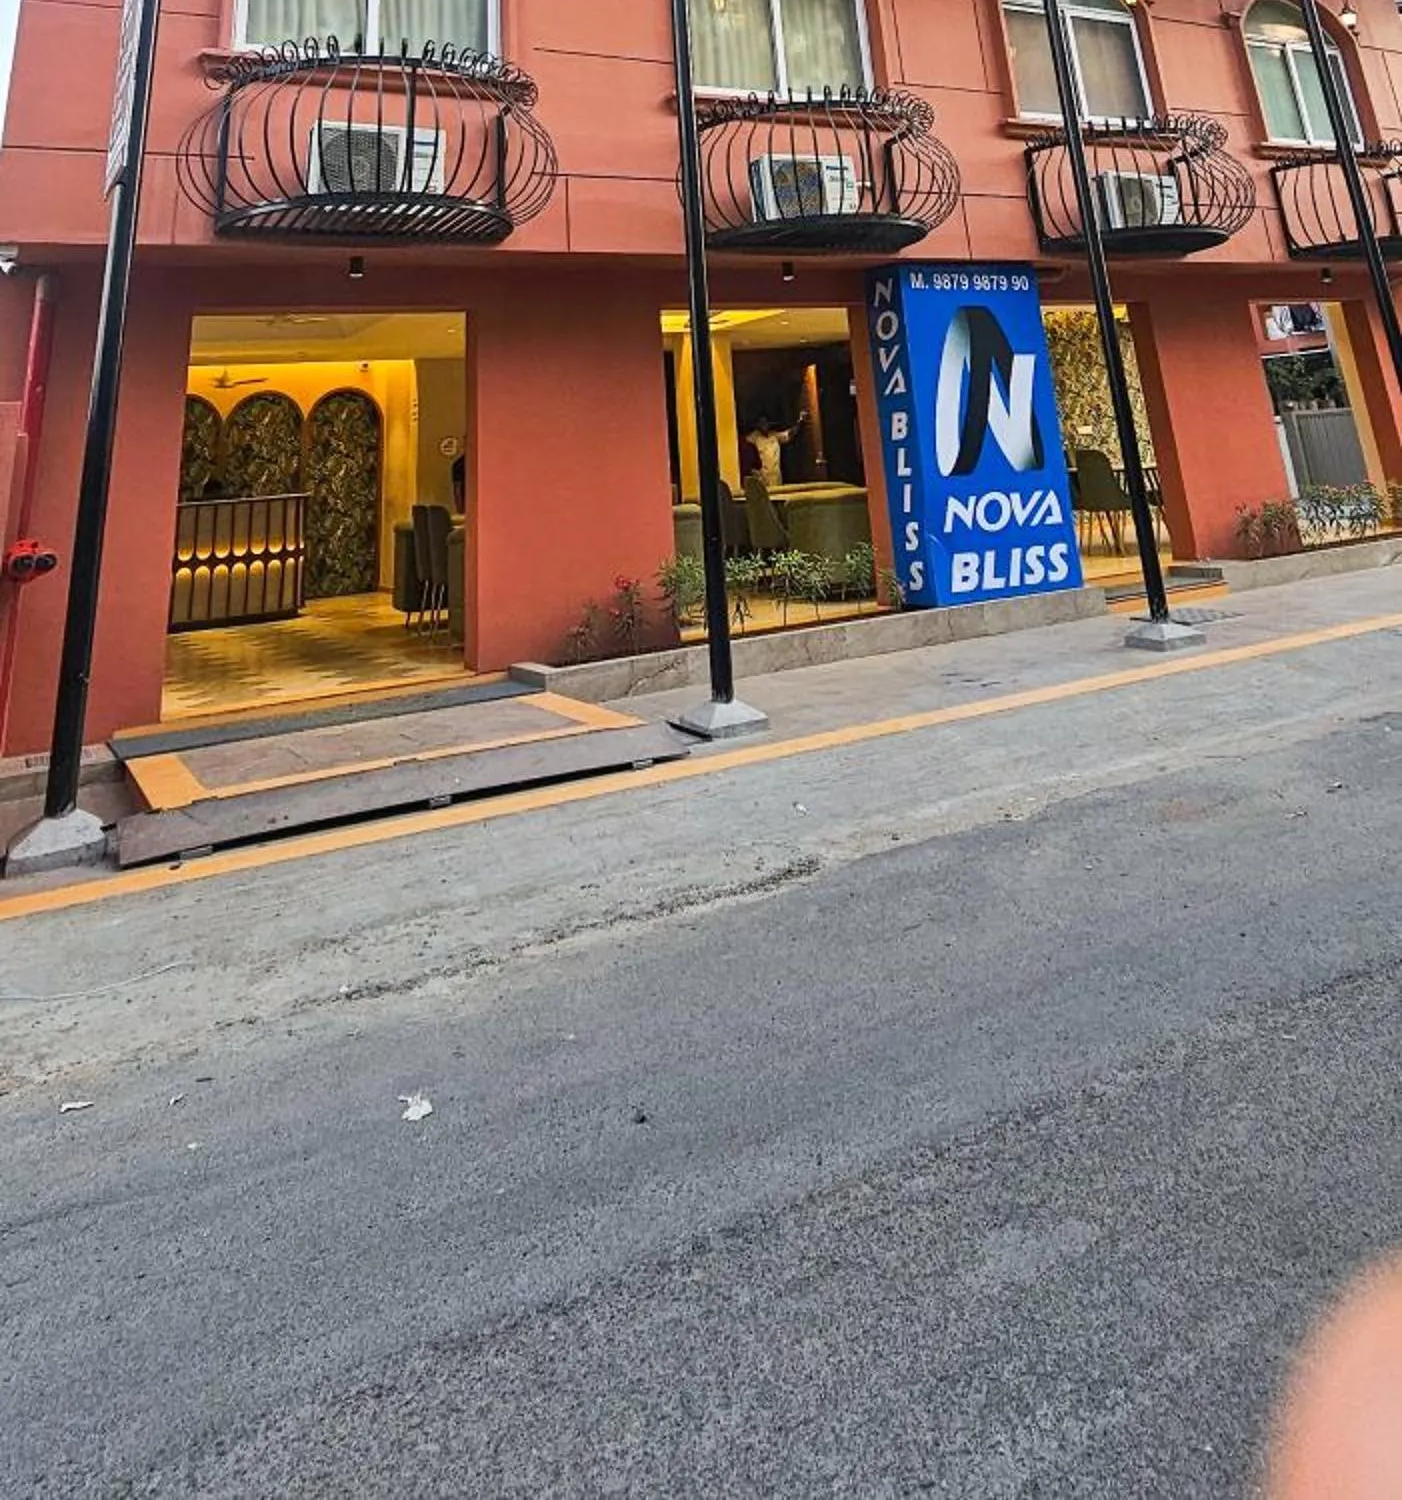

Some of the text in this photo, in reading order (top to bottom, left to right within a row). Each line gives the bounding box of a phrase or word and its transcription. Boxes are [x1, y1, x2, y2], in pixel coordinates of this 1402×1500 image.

[910, 273, 1029, 291] M. 9879 9879 90
[872, 278, 923, 592] NOVA BLISS
[943, 489, 1064, 533] NOVA
[951, 542, 1069, 593] BLISS
